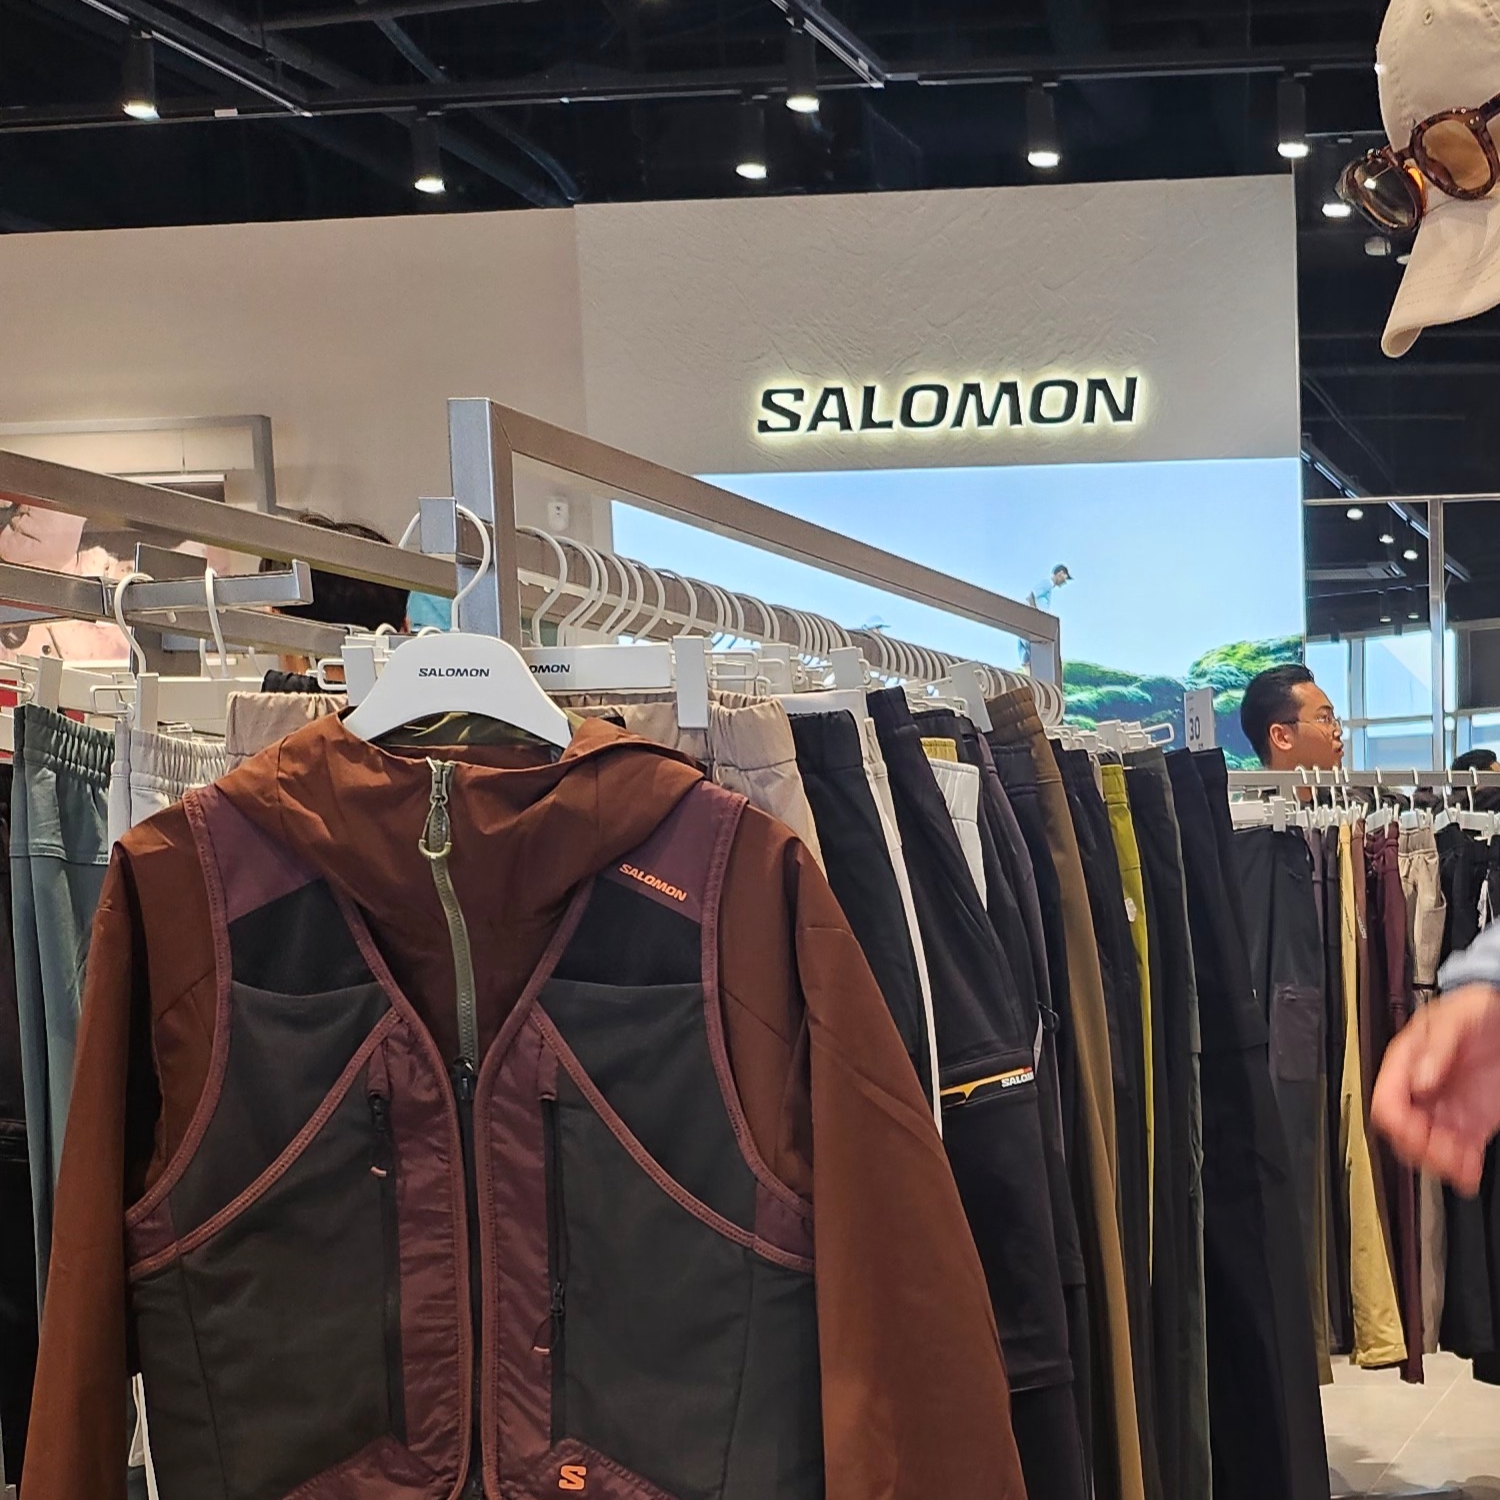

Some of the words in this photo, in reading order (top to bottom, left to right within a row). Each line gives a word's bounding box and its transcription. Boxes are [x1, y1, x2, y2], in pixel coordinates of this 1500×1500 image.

[757, 376, 1138, 433] SALOMON
[418, 667, 490, 678] SALOMON
[1189, 715, 1201, 741] 30
[619, 863, 688, 902] SALOMON
[558, 1464, 587, 1490] S
